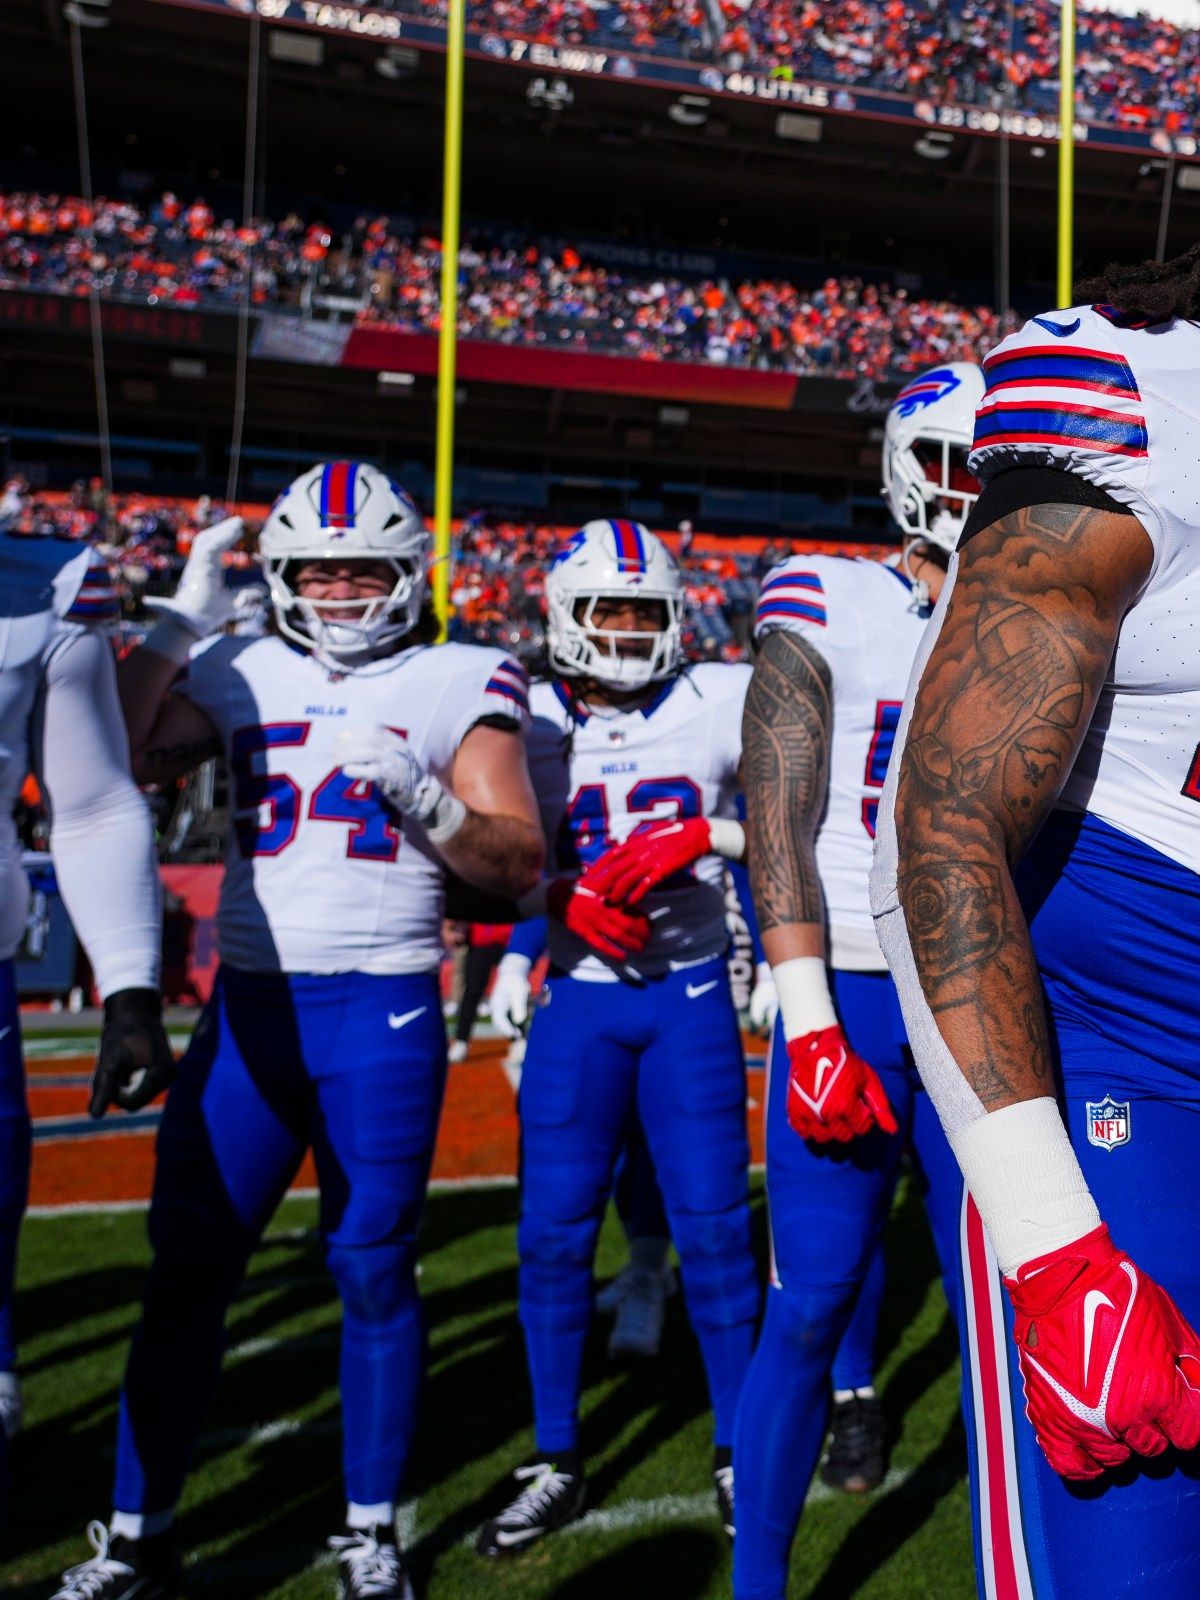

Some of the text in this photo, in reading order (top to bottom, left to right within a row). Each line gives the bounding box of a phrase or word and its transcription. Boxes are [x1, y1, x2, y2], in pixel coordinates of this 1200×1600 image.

[302, 2, 401, 39] TAYLOR
[510, 39, 607, 74] 7 ELWAY
[726, 73, 829, 107] 44 LITTLE
[967, 110, 1089, 142] GONSOULN
[655, 248, 717, 274] CLUB
[0, 295, 204, 342] VER BRONCOS
[231, 721, 408, 863] 54
[1094, 1120, 1125, 1141] NFL
